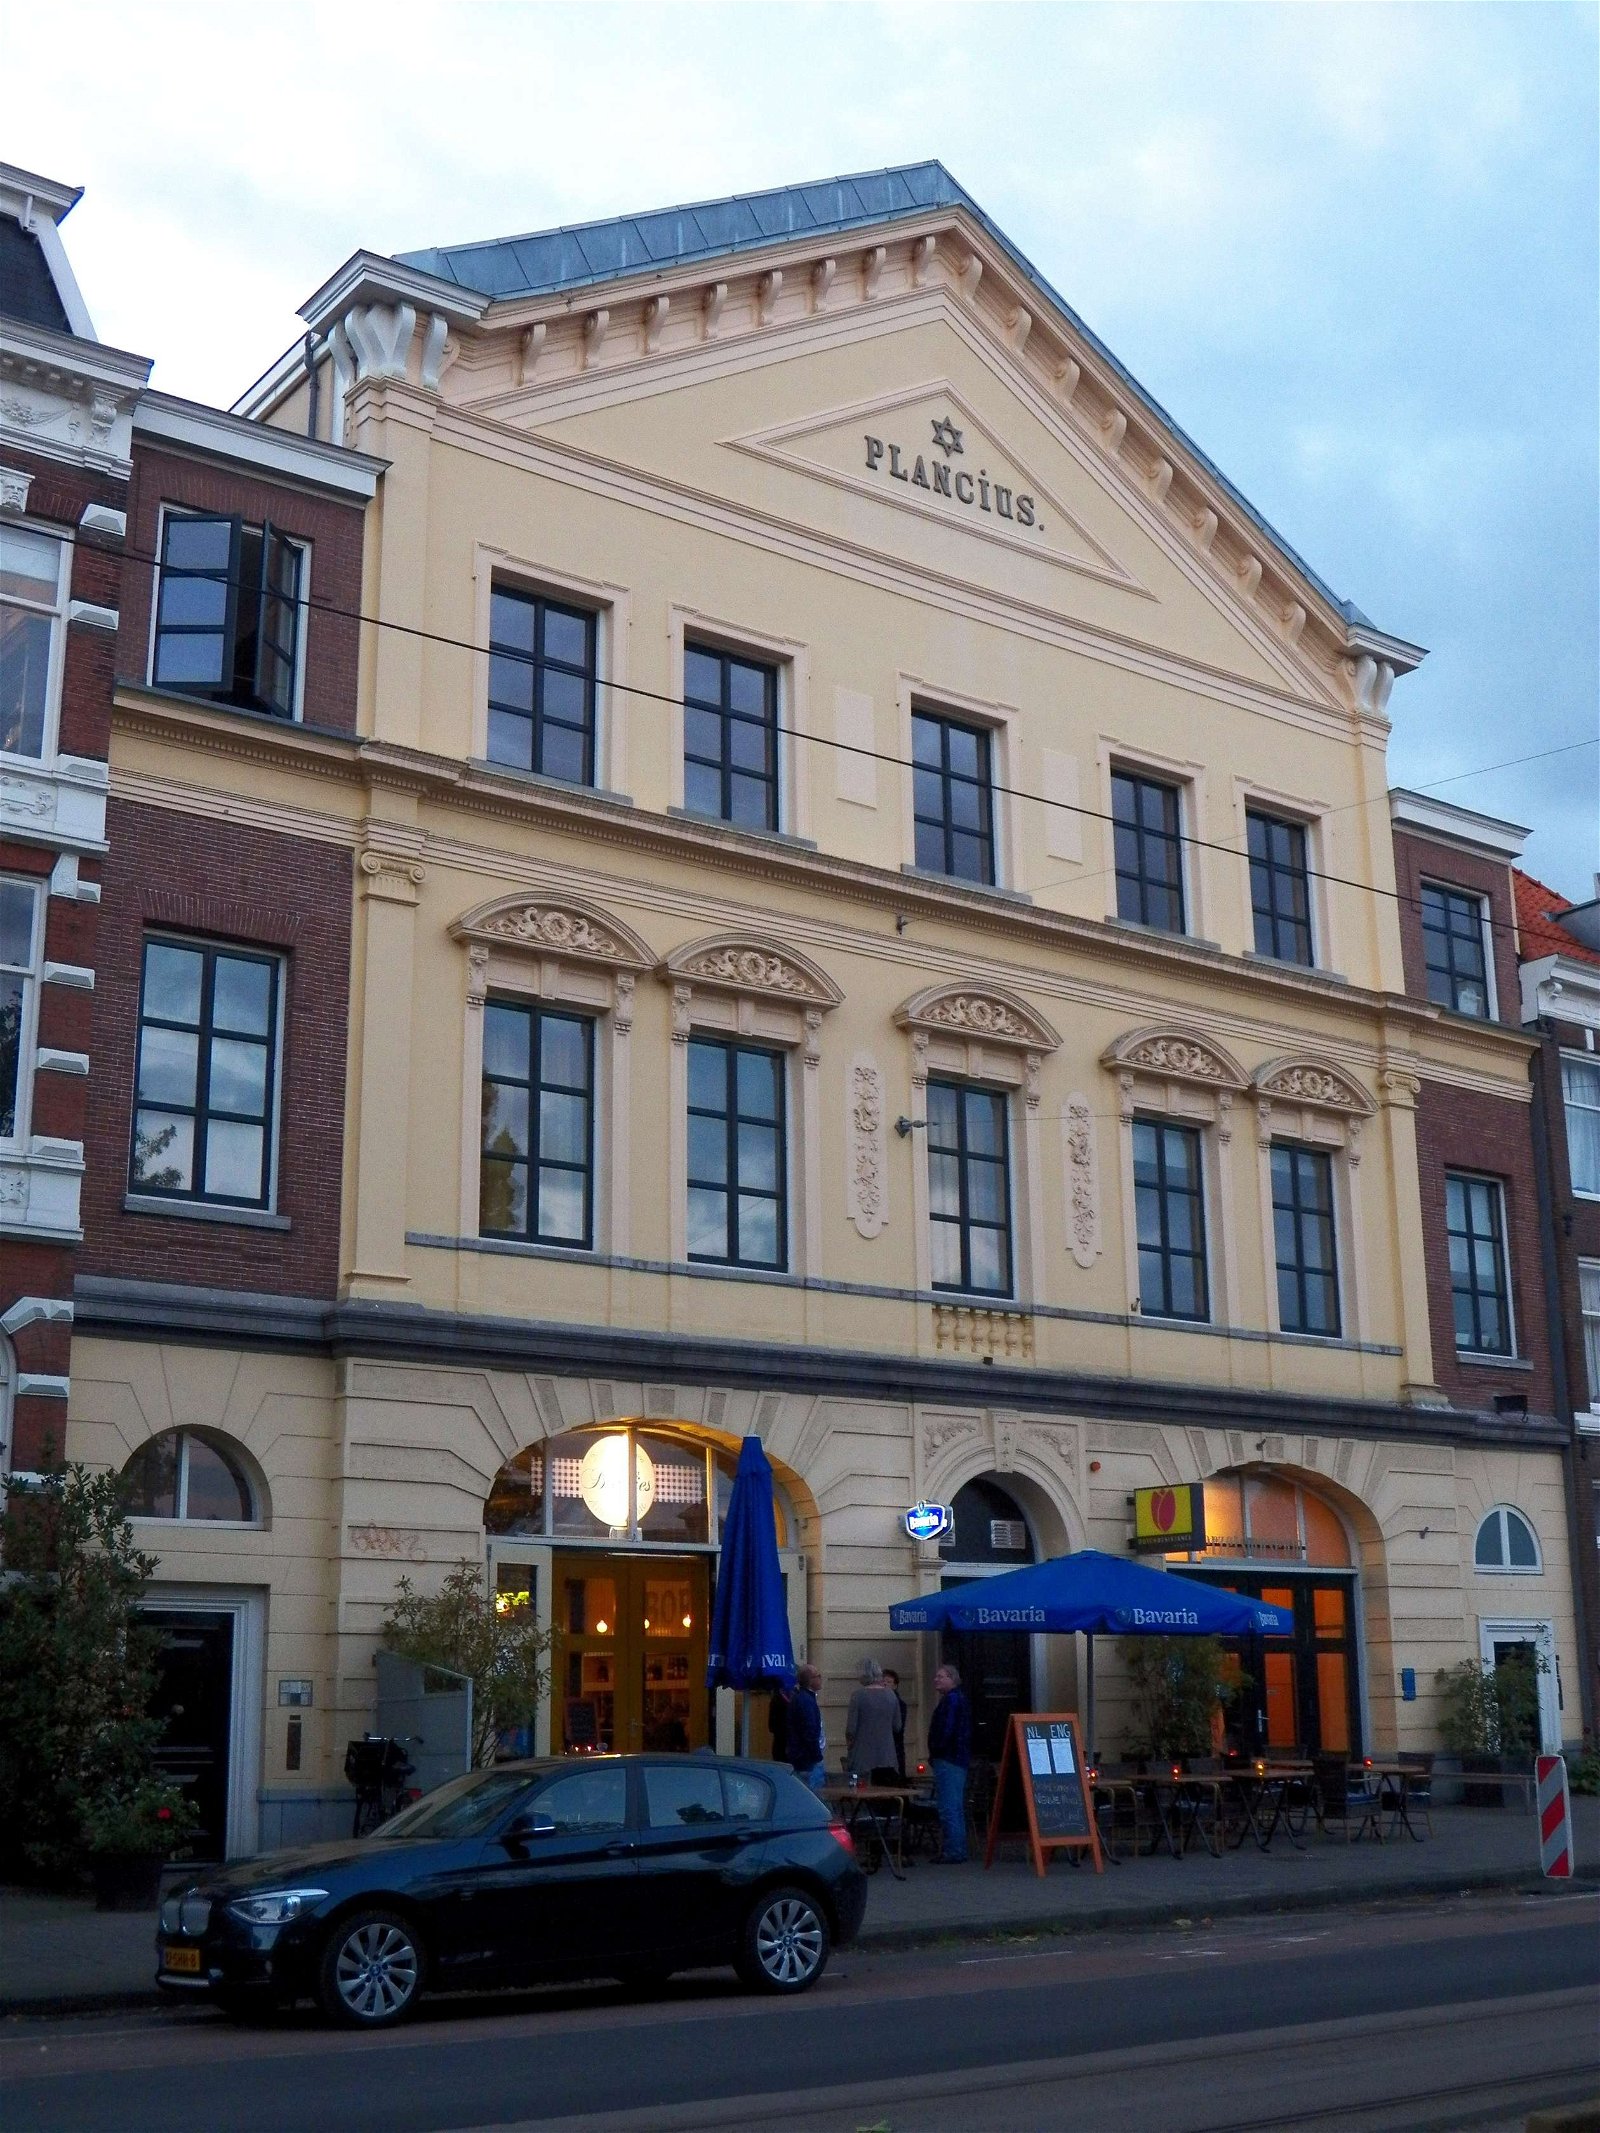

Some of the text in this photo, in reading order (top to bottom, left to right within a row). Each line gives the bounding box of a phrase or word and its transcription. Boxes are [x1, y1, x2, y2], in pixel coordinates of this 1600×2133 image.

[908, 1513, 940, 1530] Bavaria
[899, 1608, 928, 1625] Bavaria
[977, 1606, 1046, 1625] Bavaria
[1132, 1607, 1199, 1625] Bavaria
[1257, 1611, 1280, 1627] Bavaria
[1026, 1723, 1071, 1739] NL ENG
